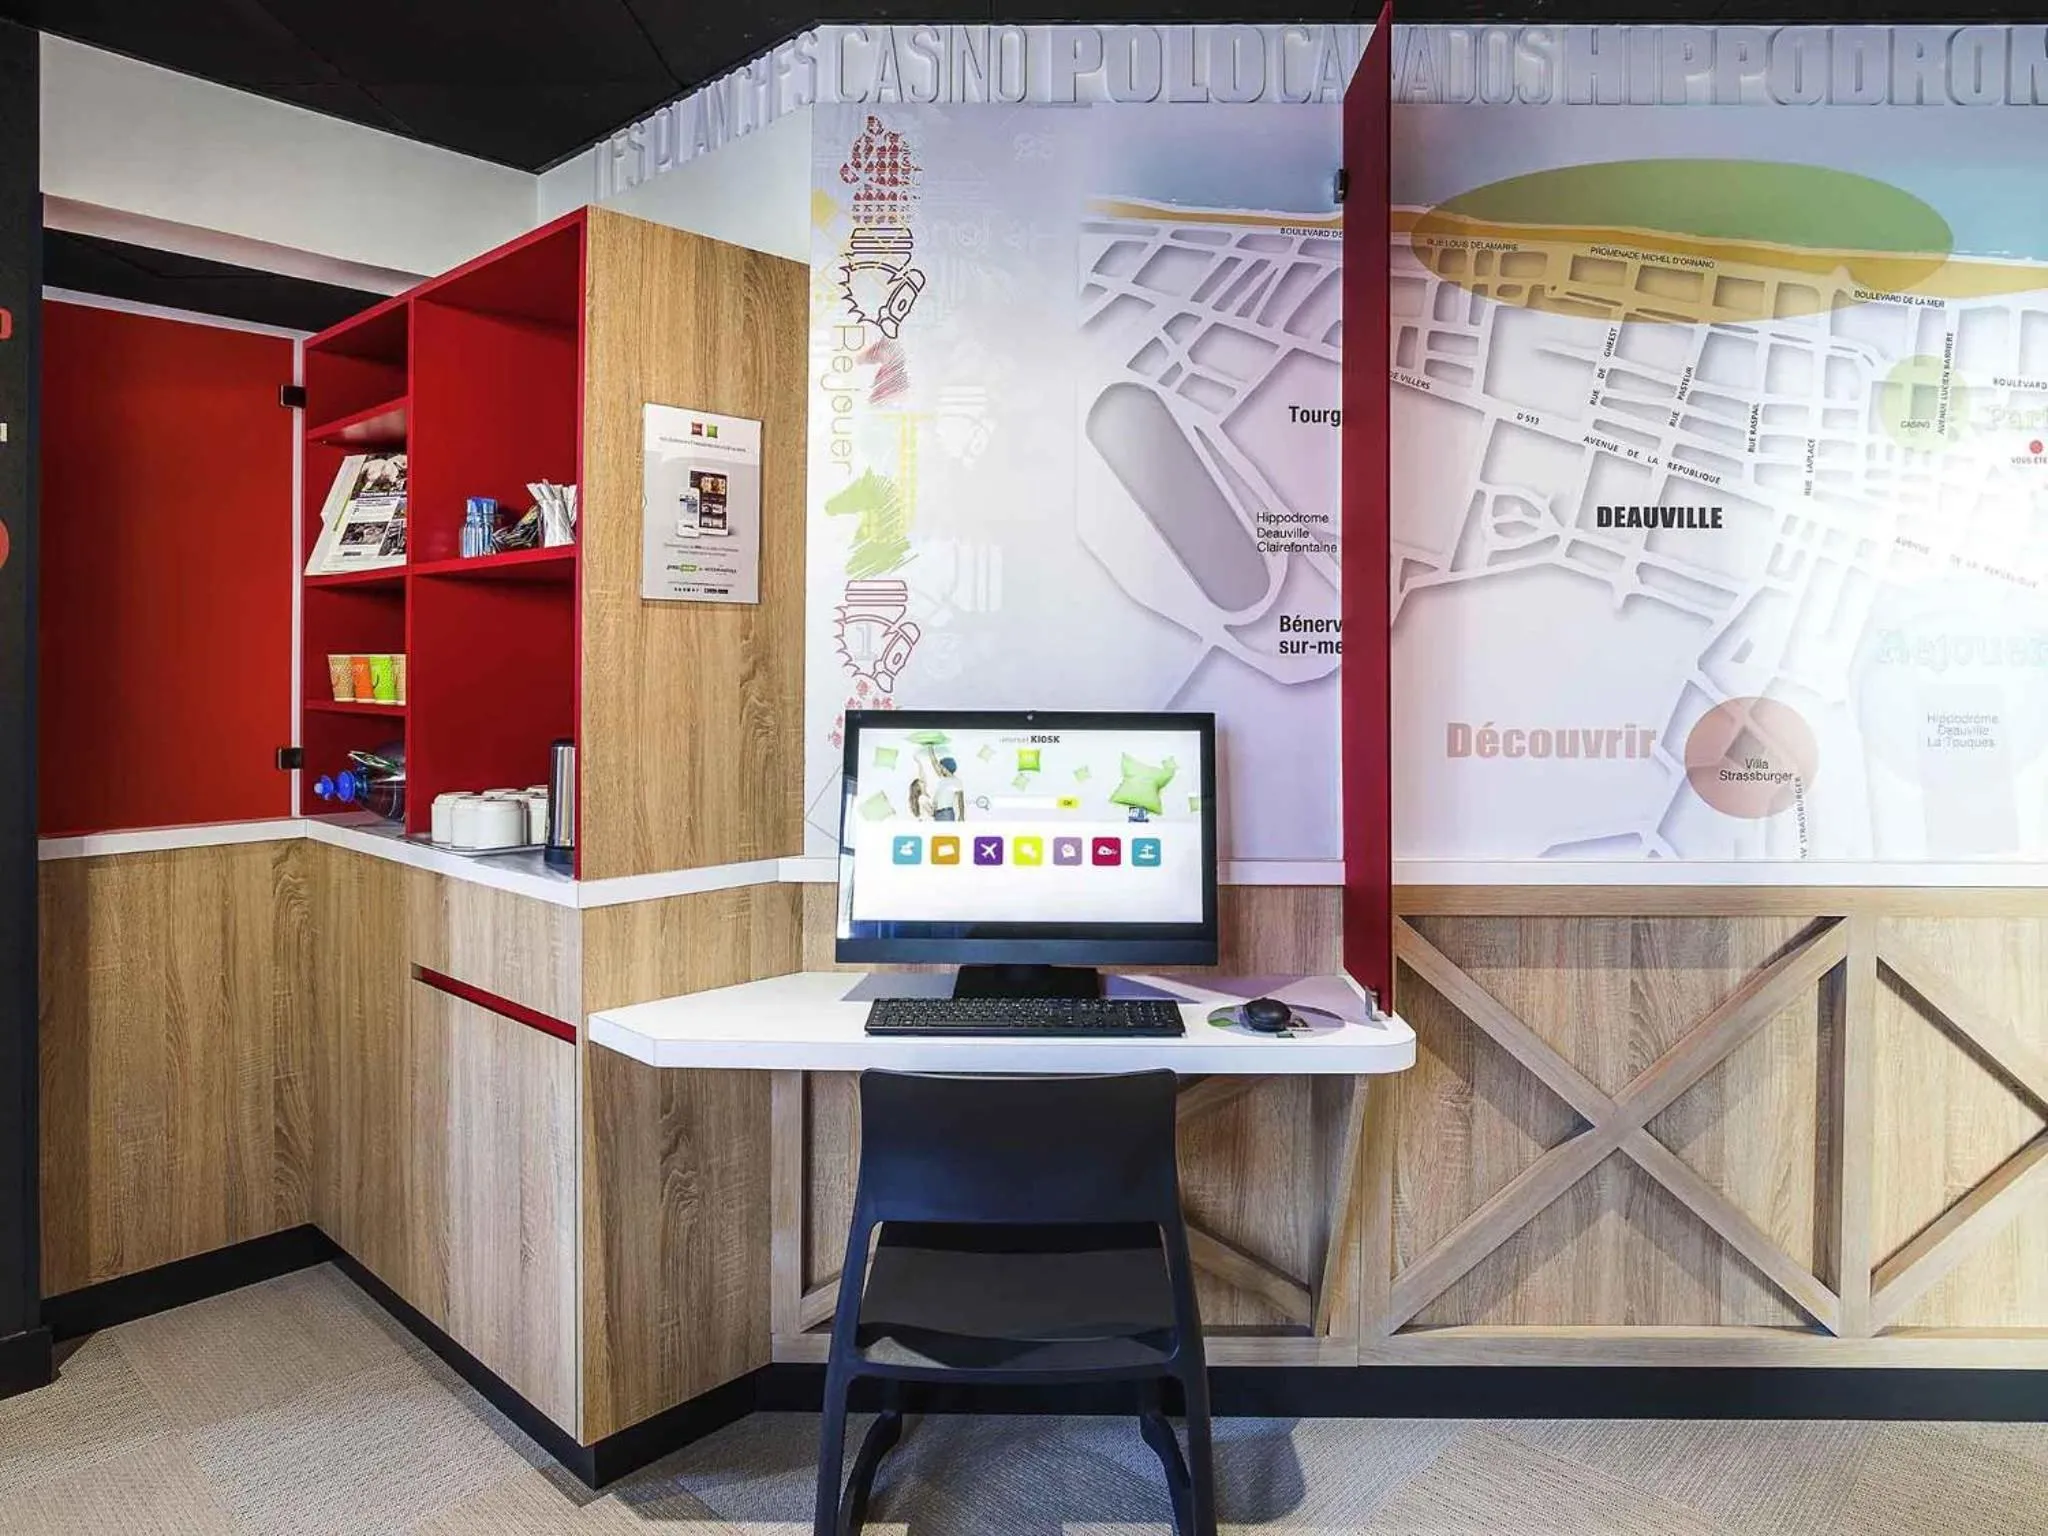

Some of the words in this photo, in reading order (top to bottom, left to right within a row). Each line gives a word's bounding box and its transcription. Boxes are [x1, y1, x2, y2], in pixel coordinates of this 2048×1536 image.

[836, 25, 1029, 104] CASINO
[1050, 25, 1267, 104] POLO
[1275, 25, 1556, 105] CAADOS
[1280, 227, 1331, 238] BOULEVARD
[1590, 247, 1640, 261] PROMENADE
[1640, 254, 1672, 265] MICHEL
[1854, 290, 1901, 303] BOULEVARD
[1902, 296, 1914, 305] DE
[1915, 297, 1925, 306] LA
[1925, 298, 1945, 308] MER
[1590, 389, 1601, 406] RUE
[1597, 368, 1606, 379] DE
[1603, 327, 1618, 357] GHEEST
[1669, 411, 1681, 427] RUE
[1677, 366, 1694, 400] PASTEUR
[1289, 406, 1342, 428] Tourg
[1747, 438, 1756, 453] RUE
[1584, 435, 1619, 453] AVENUE
[1627, 449, 1640, 458] DE
[1647, 456, 1659, 466] LA
[1667, 462, 1722, 485] REPUBLIQUE
[1256, 512, 1329, 527] Hippodrome
[1597, 507, 1723, 529] DEAUVILLE
[1257, 527, 1310, 539] Deauville
[1256, 541, 1338, 554] Clairefontaine
[1927, 711, 2000, 725] Hippodrome
[1030, 735, 1061, 744] KIOSK
[1446, 721, 1657, 759] Découvrir
[1744, 758, 1769, 770] Villa
[1719, 770, 1794, 784] Strassburger
